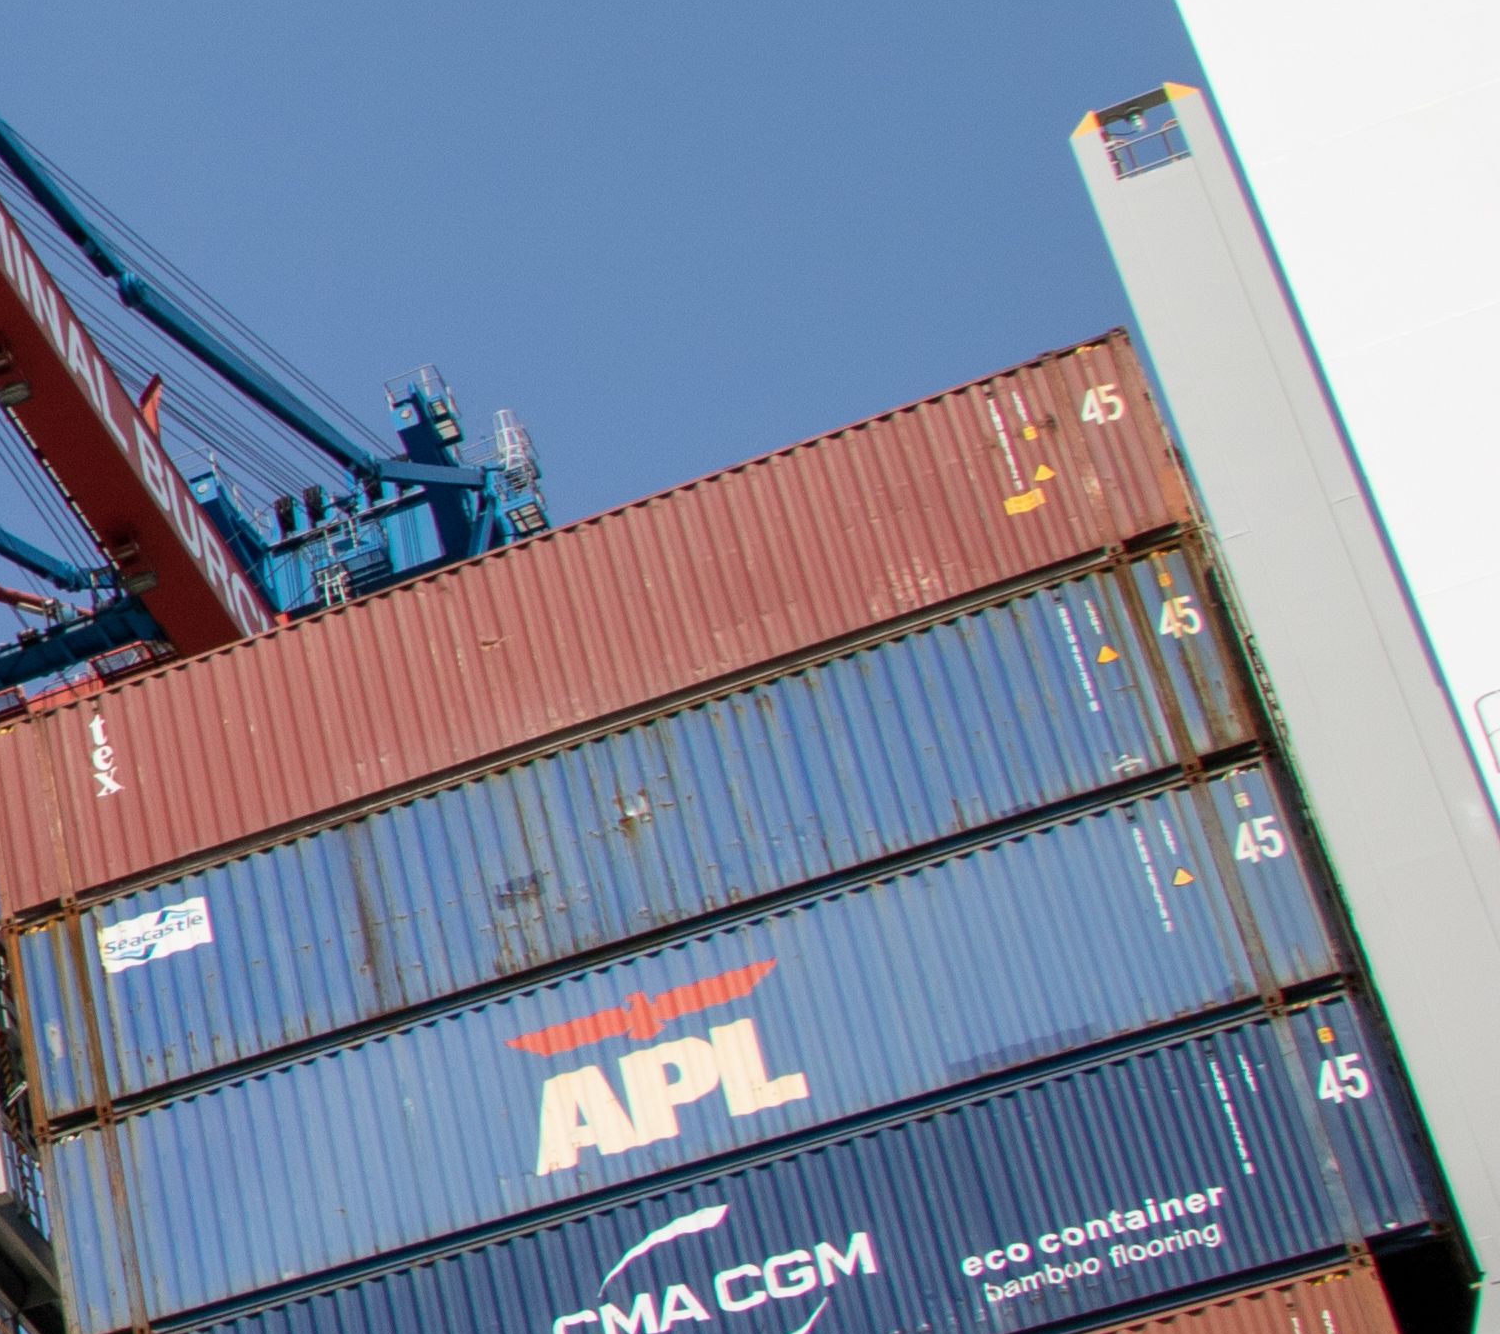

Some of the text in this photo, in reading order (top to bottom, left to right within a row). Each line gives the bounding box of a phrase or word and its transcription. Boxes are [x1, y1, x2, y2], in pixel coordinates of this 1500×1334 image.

[1081, 383, 1125, 425] 45
[1159, 594, 1204, 639] 45
[88, 714, 126, 798] tex
[1233, 816, 1286, 864] 45
[103, 914, 205, 955] Seacastle
[535, 1017, 810, 1178] APL
[1316, 1054, 1371, 1106] 45
[961, 1184, 1227, 1279] eco container
[984, 1220, 1222, 1305] bamboo flooring
[717, 1231, 878, 1315] CGM
